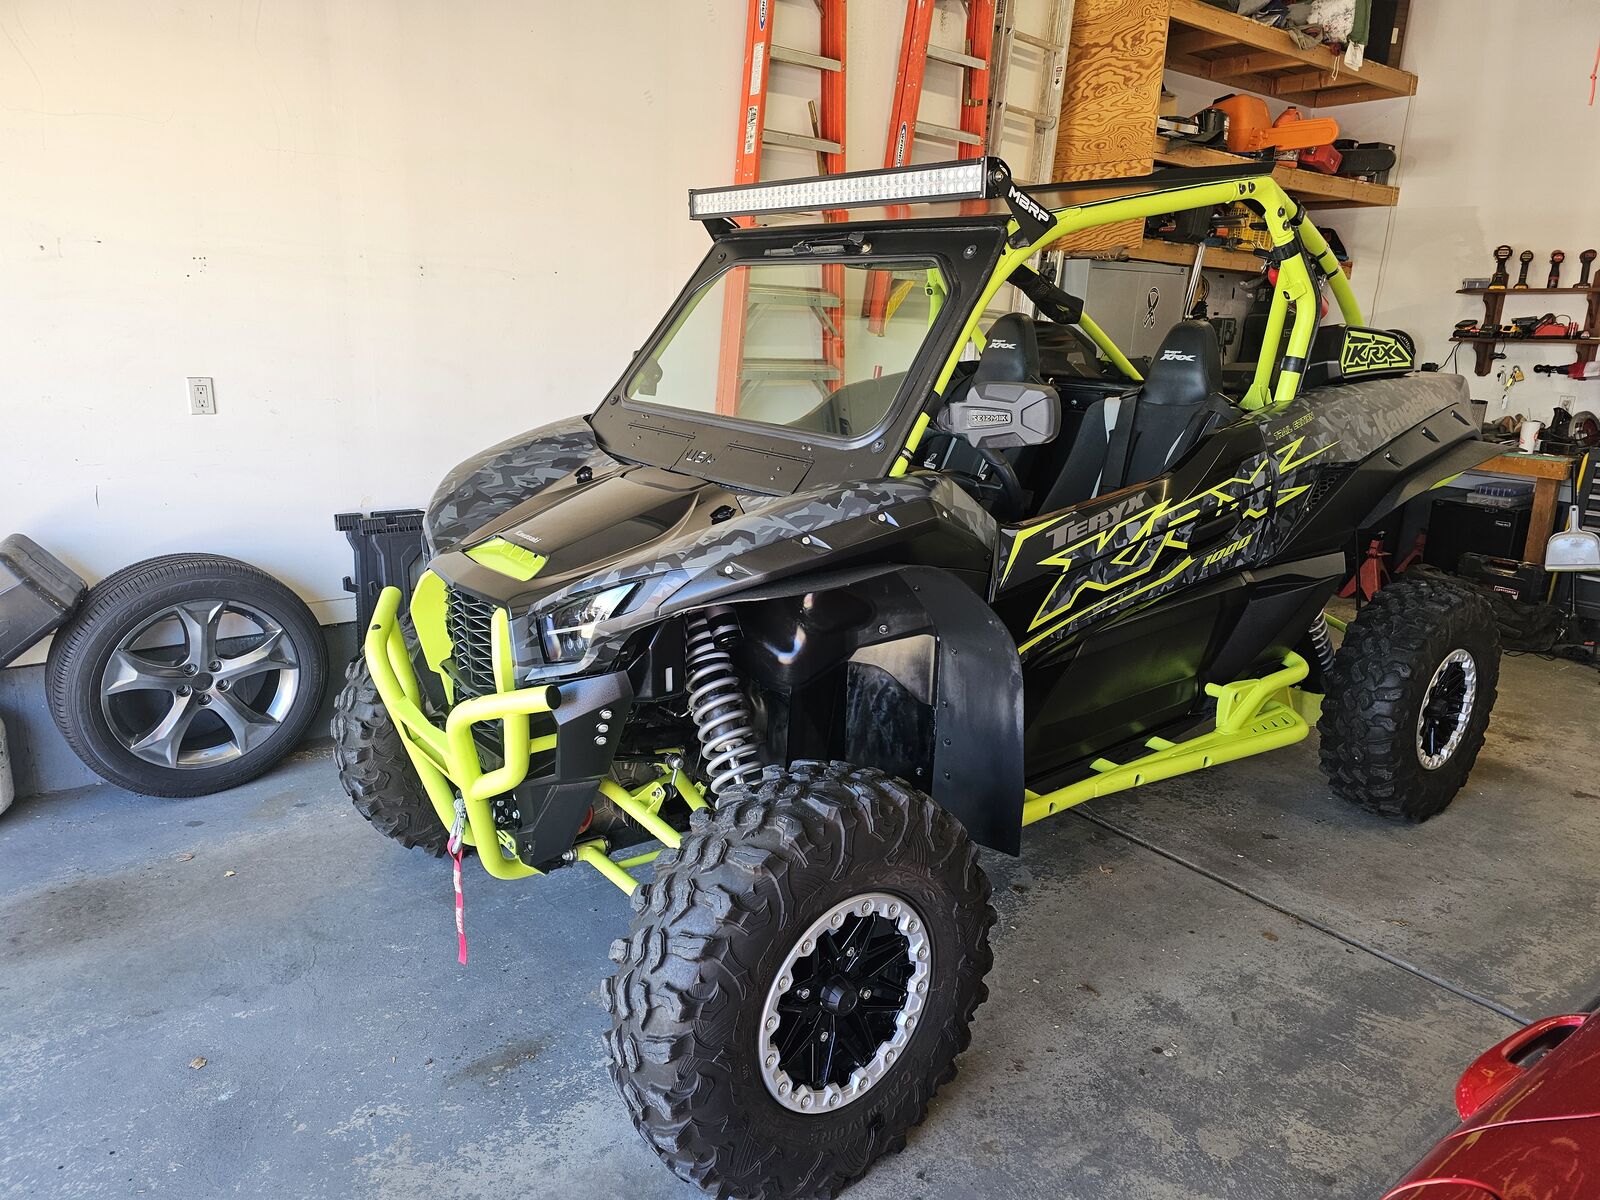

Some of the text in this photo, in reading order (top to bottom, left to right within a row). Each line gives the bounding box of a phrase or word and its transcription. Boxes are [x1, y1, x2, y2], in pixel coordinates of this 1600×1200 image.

[1008, 185, 1050, 222] MBRP
[1347, 343, 1402, 364] KRX
[1273, 410, 1315, 441] TRAIL EDITION
[513, 530, 542, 544] Kawasaki
[1203, 533, 1253, 567] 1000
